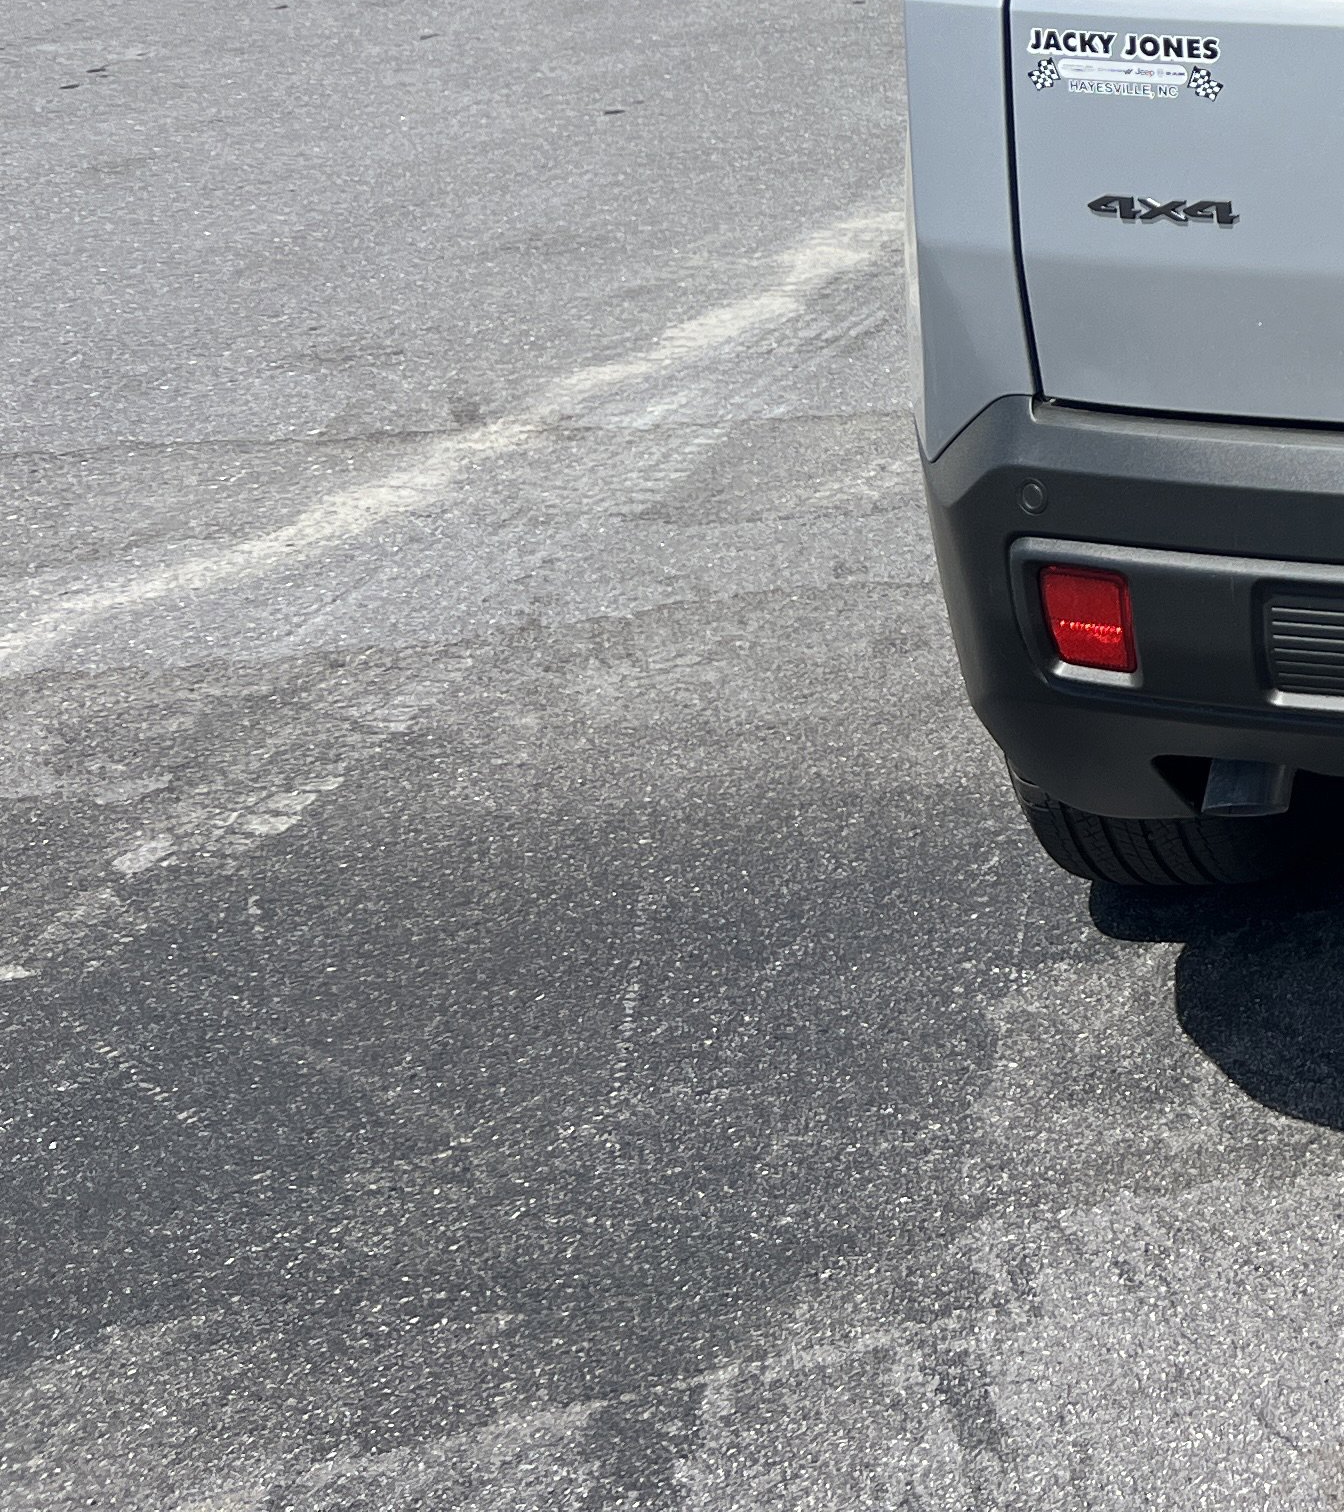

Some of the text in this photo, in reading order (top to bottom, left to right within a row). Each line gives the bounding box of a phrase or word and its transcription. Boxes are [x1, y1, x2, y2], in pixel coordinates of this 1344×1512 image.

[1029, 28, 1220, 61] JACKY JONES
[1070, 80, 1179, 99] HAYESVILLE, NC
